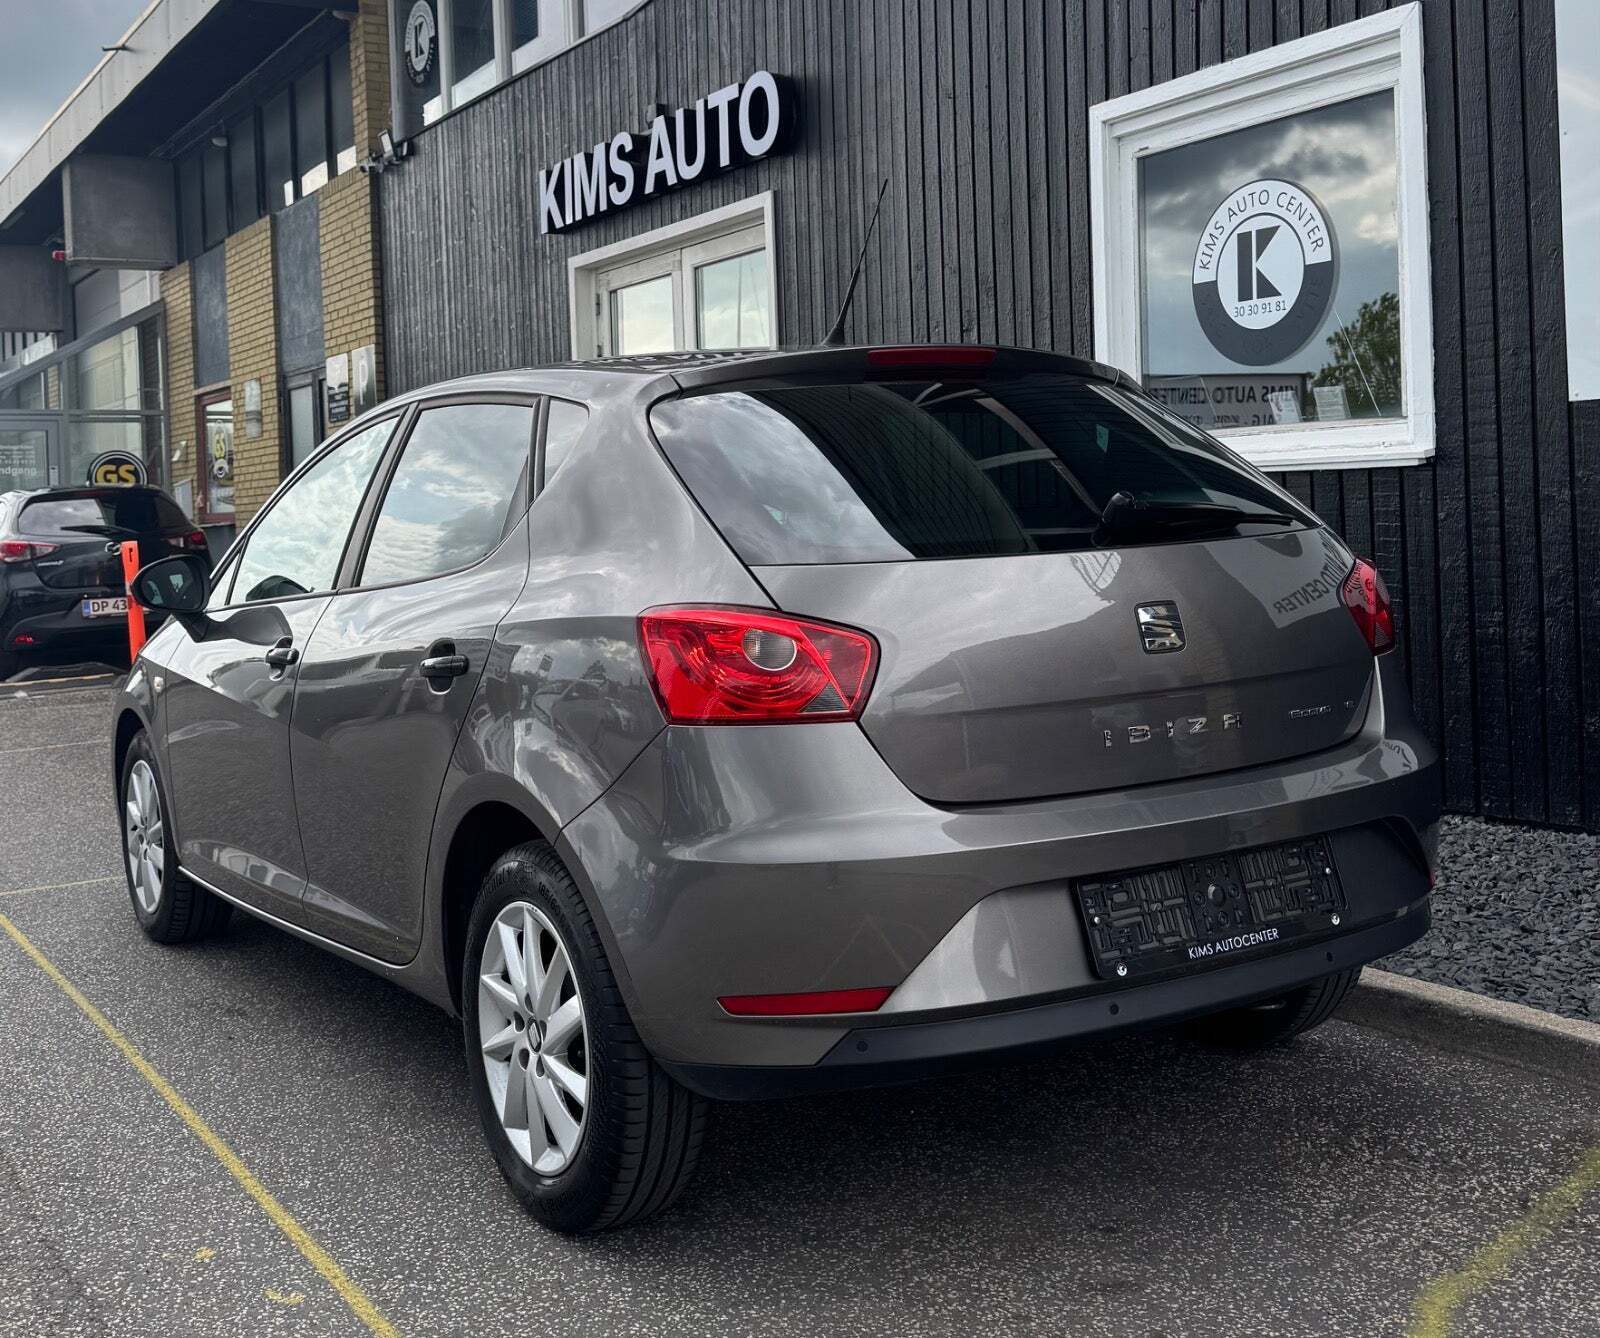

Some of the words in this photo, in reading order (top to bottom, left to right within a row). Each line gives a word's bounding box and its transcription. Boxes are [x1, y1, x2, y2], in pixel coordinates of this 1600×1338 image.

[539, 131, 634, 235] KIMS
[644, 70, 781, 195] AUTO
[1199, 220, 1226, 270] KIMS
[1227, 189, 1270, 222] AUTO
[1276, 191, 1325, 253] CENTER
[1236, 225, 1282, 302] K
[1234, 306, 1246, 318] 30
[1247, 304, 1259, 317] 30
[1261, 302, 1273, 313] 91
[1275, 300, 1288, 312] 81
[95, 464, 137, 487] GS
[91, 601, 109, 613] DP
[112, 599, 128, 611] 43
[1188, 943, 1214, 960] KIMS
[1215, 928, 1280, 953] AUTOCENTER
